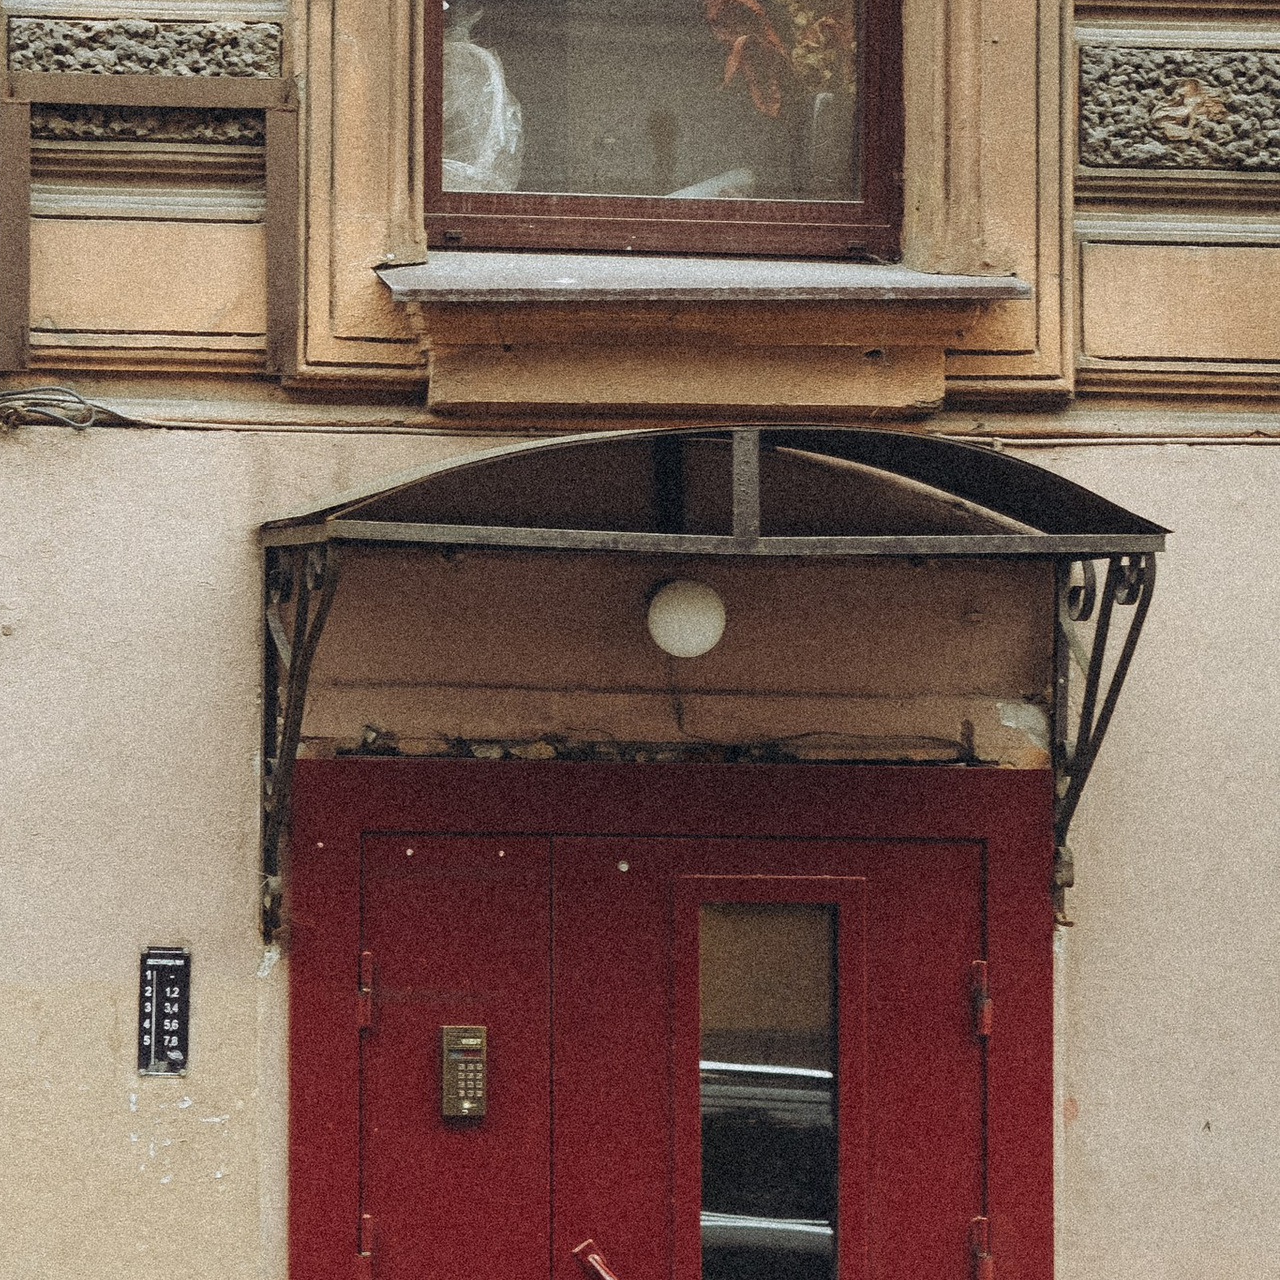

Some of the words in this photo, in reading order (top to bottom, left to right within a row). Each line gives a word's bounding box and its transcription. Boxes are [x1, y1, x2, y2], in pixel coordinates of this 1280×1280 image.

[145, 970, 152, 980] 1
[144, 986, 152, 997] 2
[144, 1002, 152, 1013] 3
[164, 1002, 179, 1014] 3,4
[143, 1019, 151, 1029] 4
[163, 1019, 179, 1031] 5,6
[143, 1035, 151, 1046] 5
[163, 1036, 179, 1047] 7,8
